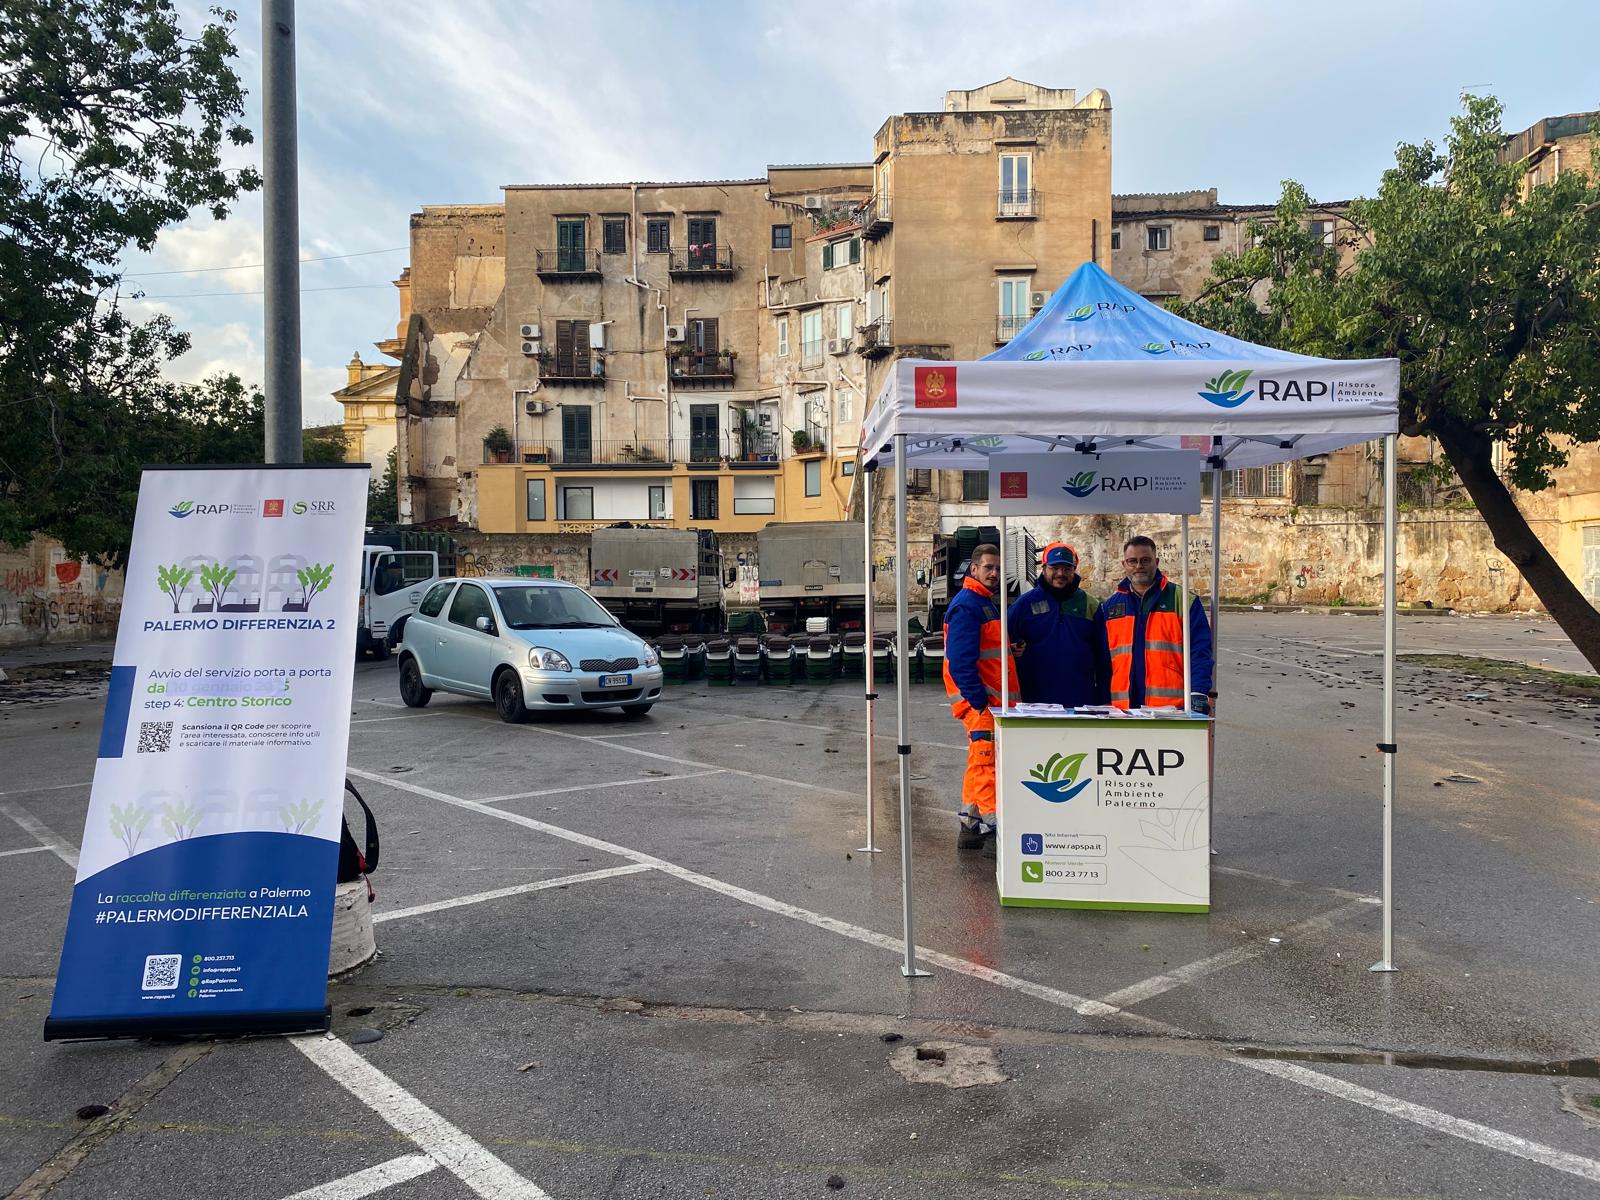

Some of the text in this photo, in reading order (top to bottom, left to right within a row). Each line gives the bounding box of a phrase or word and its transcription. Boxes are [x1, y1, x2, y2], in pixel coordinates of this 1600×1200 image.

[1097, 303, 1135, 313] RAP
[1050, 344, 1092, 354] RAP
[1259, 380, 1327, 401] RAP
[1102, 477, 1147, 491] RAP
[196, 504, 228, 514] RAP
[311, 500, 335, 511] SRR
[144, 619, 335, 632] PALERMO DIFFERENZIA 2
[150, 668, 331, 679] Avvio del servizio porta a porta
[144, 696, 292, 710] step 4: Centro Storico
[1097, 748, 1184, 776] RAP
[98, 888, 311, 904] La raccolta differenziata a Palermo
[95, 905, 308, 924] #PALERMODIFFERENZIALA
